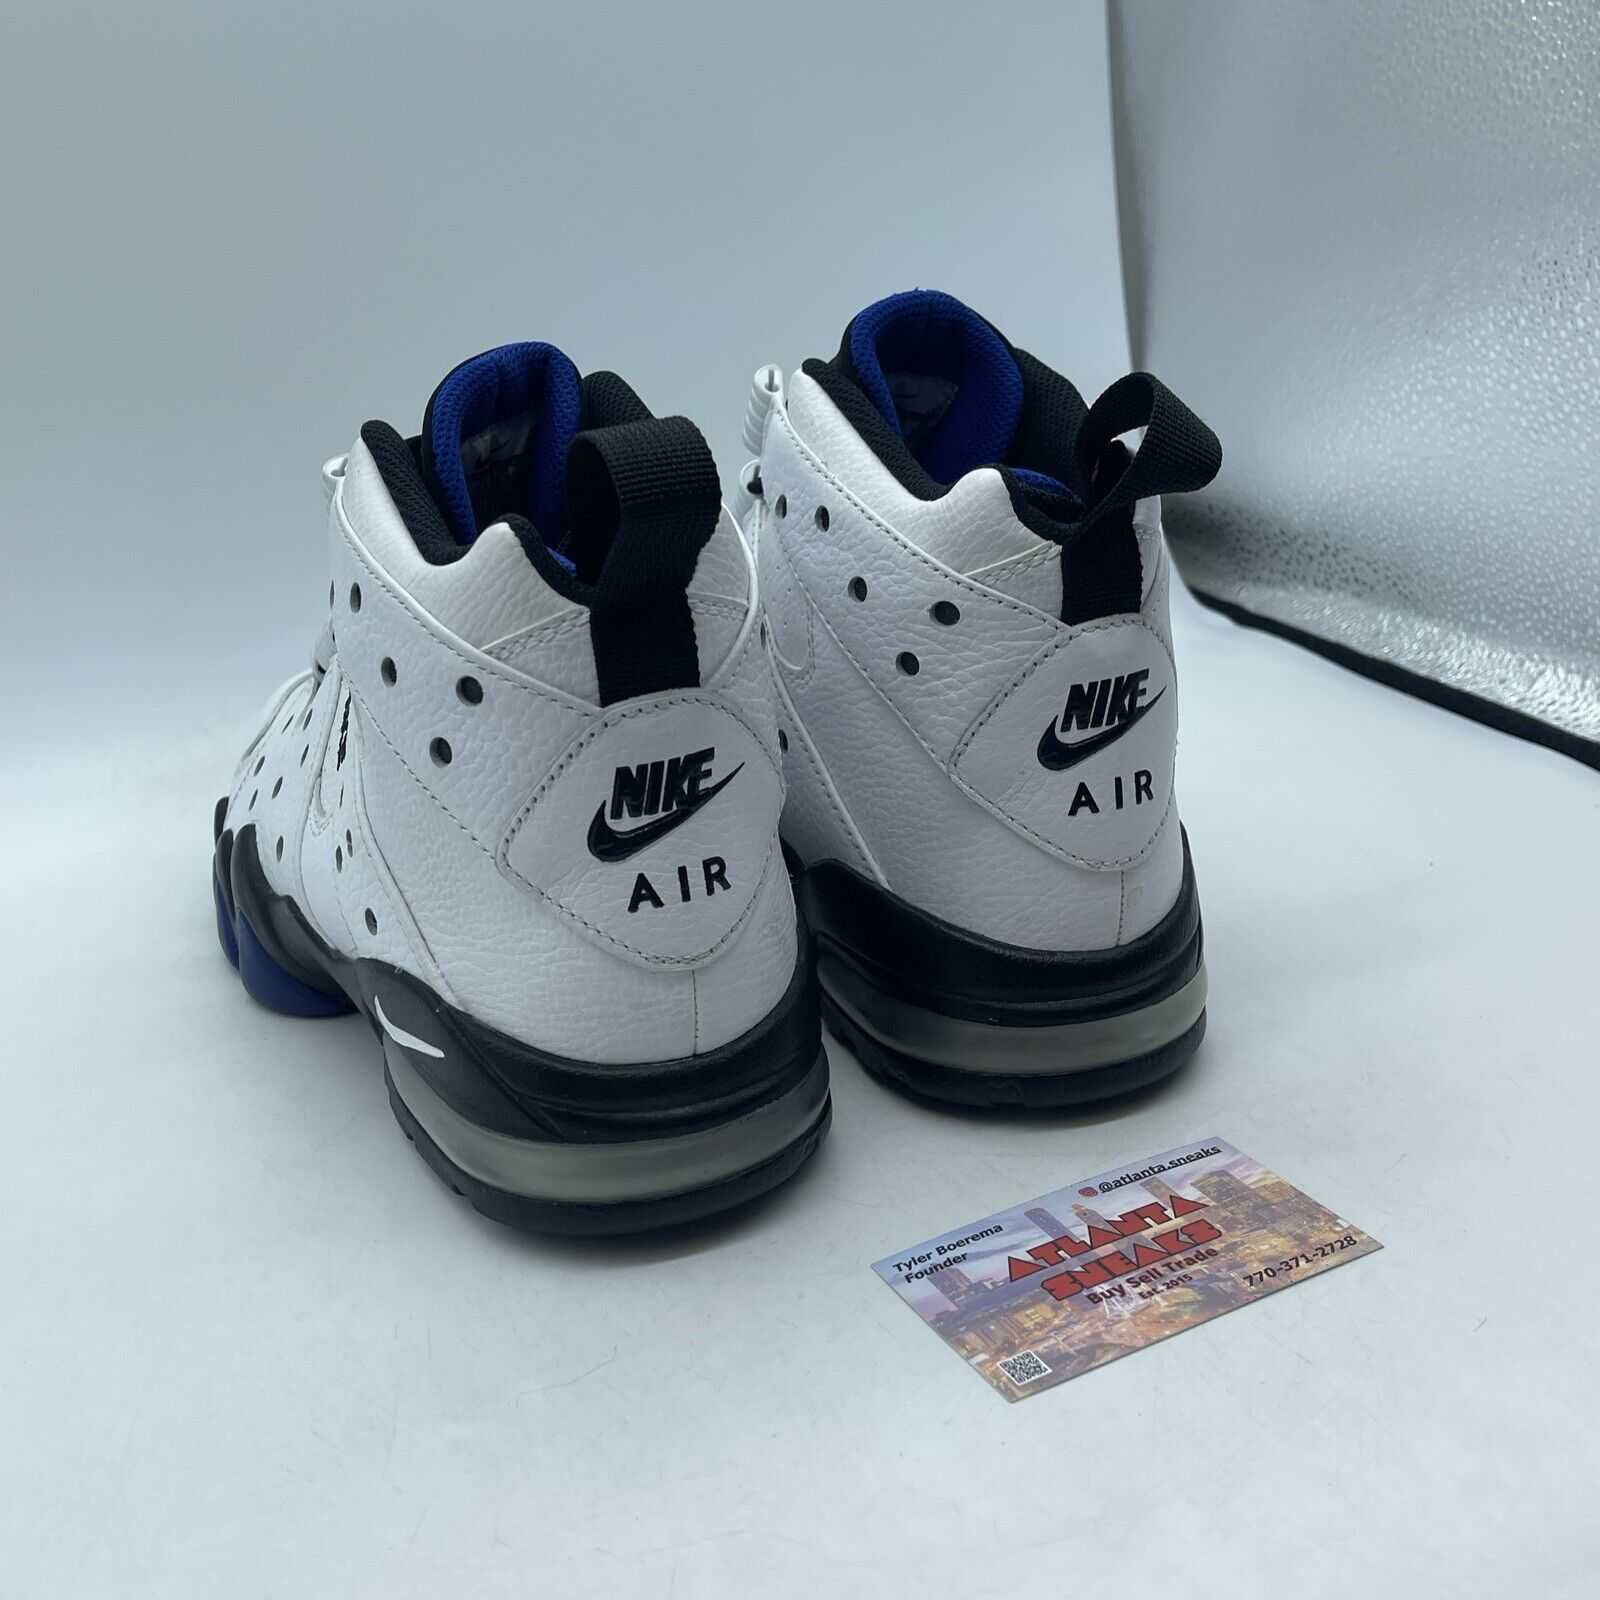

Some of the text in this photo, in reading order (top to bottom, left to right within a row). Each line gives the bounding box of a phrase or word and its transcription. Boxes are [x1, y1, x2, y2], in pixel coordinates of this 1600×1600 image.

[1060, 668, 1150, 733] NIKE
[610, 746, 715, 820] NIKE
[1067, 769, 1154, 817] AIR
[627, 856, 732, 914] AIR
[1098, 1145, 1223, 1194] @atlanta.sneaks
[893, 1224, 1004, 1273] Tyler Boerema
[1008, 1195, 1209, 1282] ATLANTA
[1041, 1218, 1223, 1301] SNEAKS
[1243, 1235, 1358, 1287] 770-371-2728
[904, 1252, 968, 1284] Founder
[1086, 1248, 1219, 1305] Buy Sell Trade
[1138, 1274, 1193, 1299] Est. 2015
